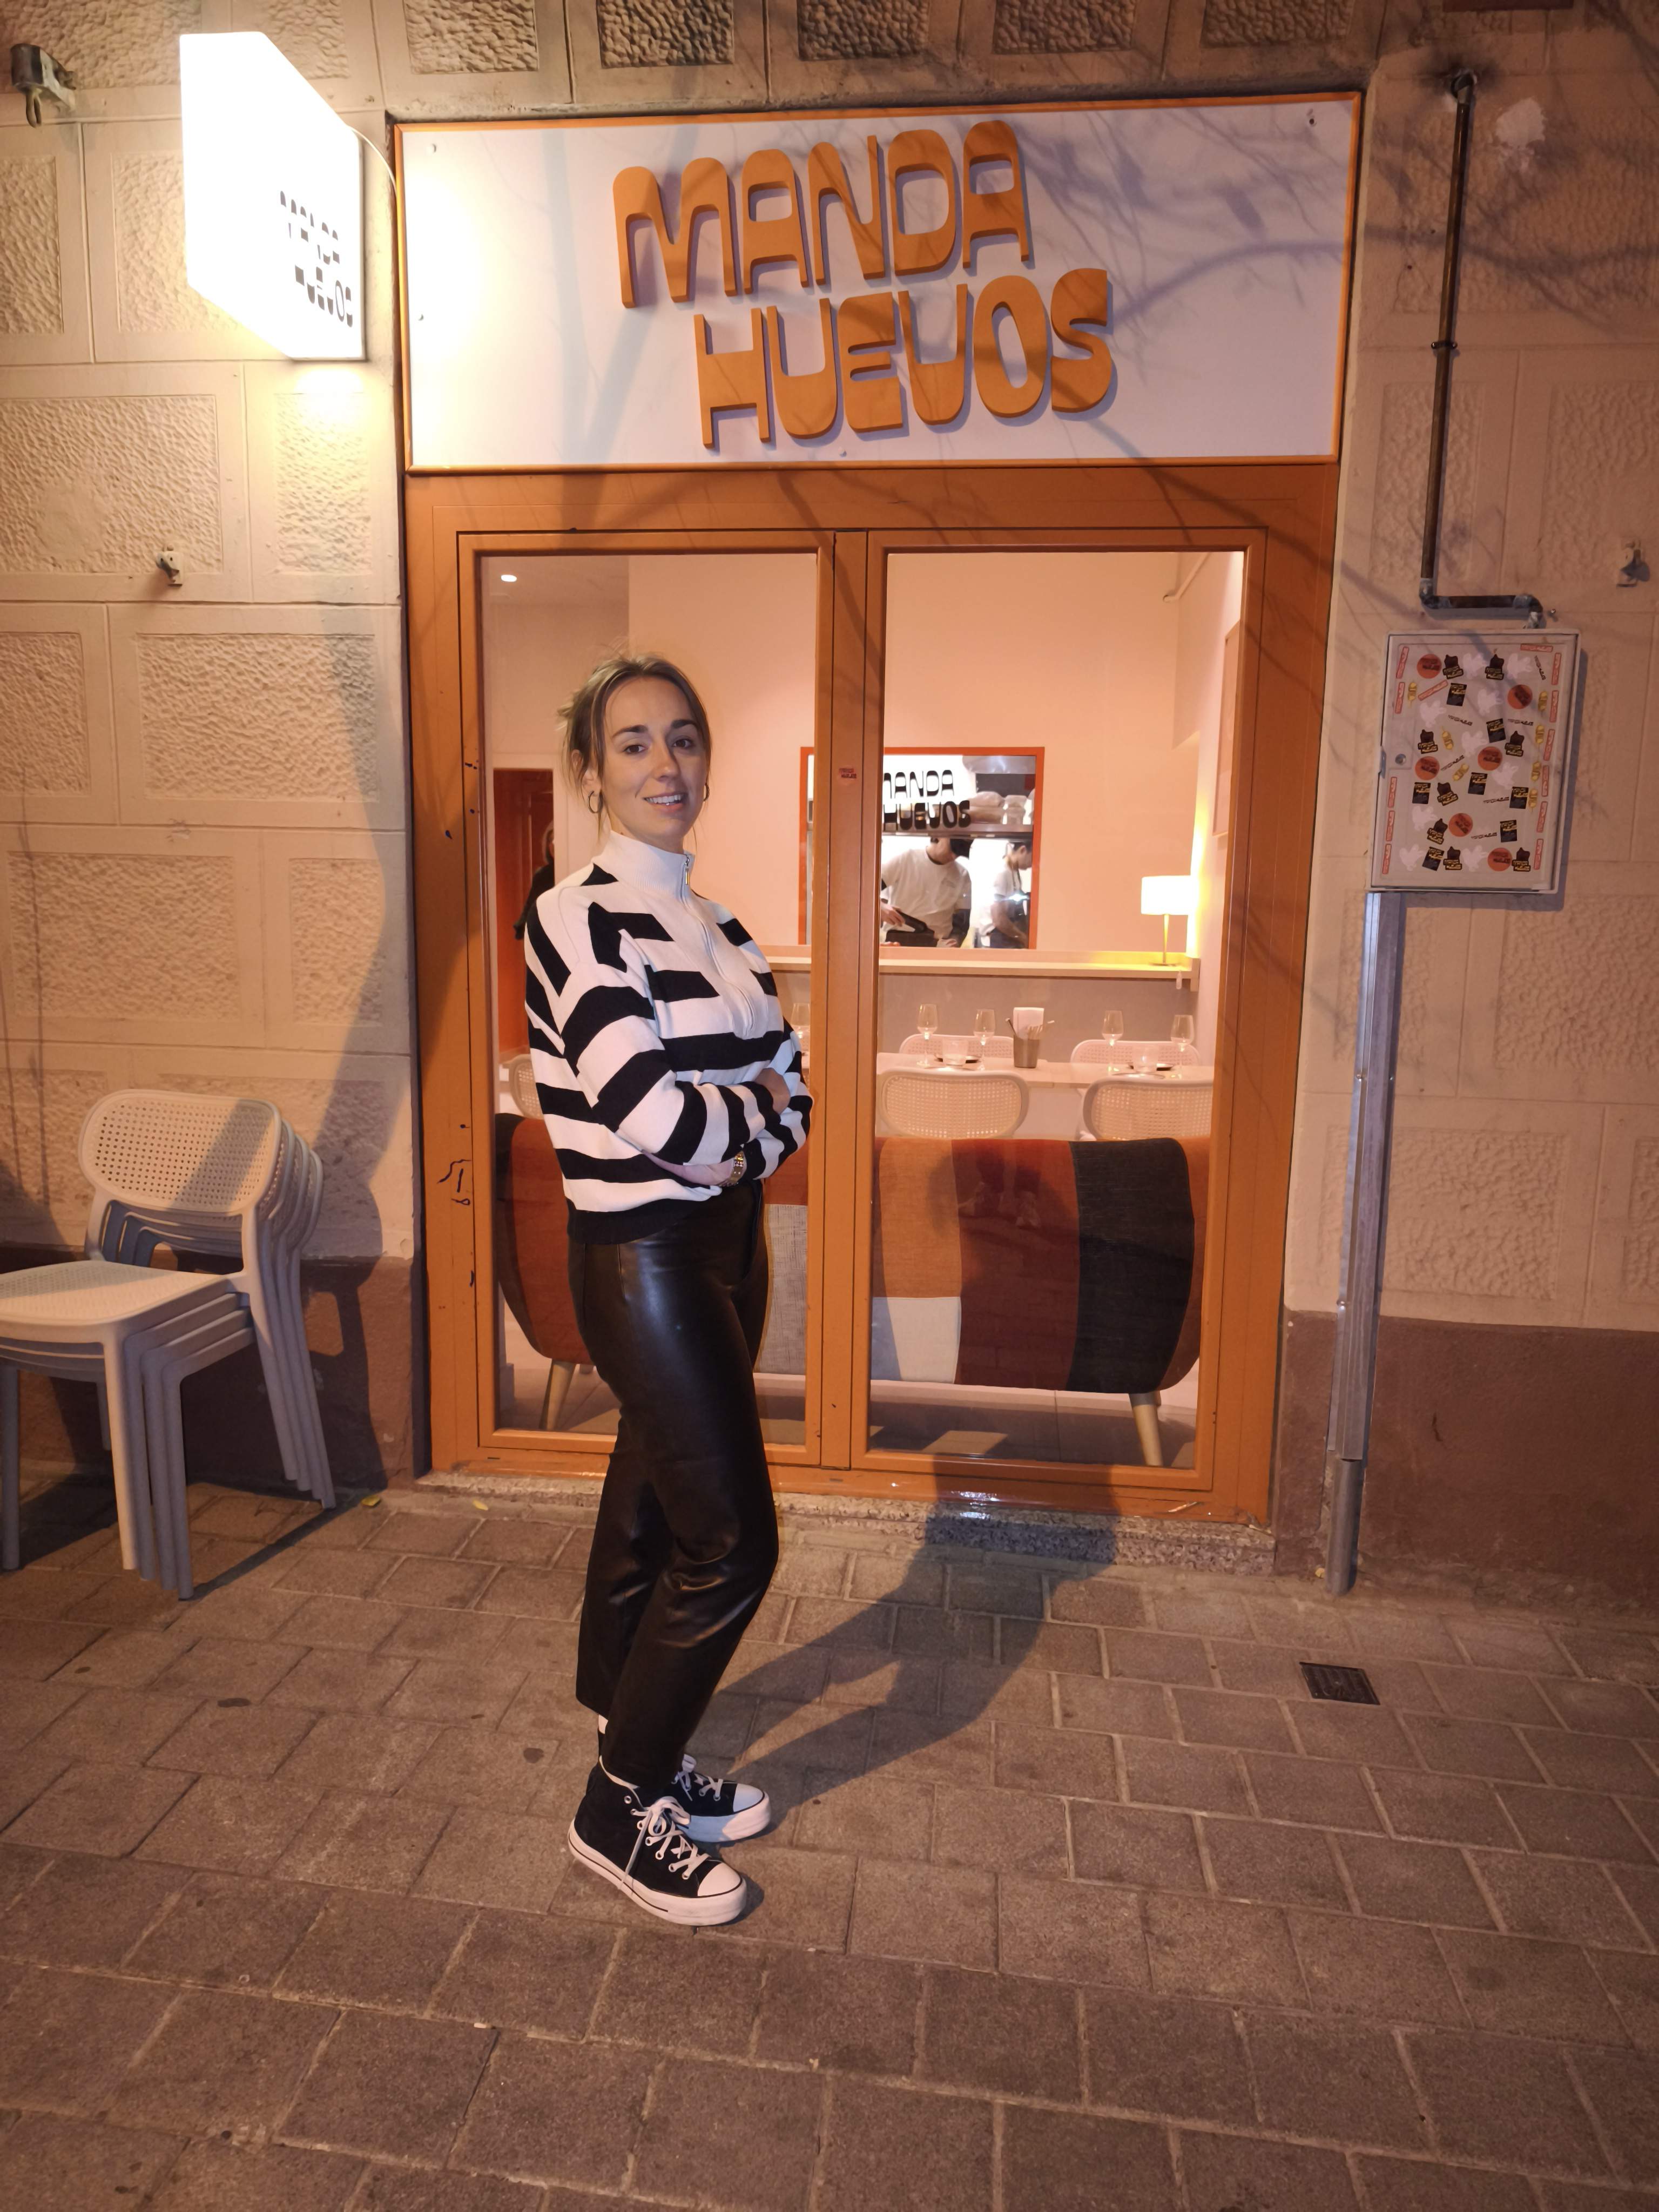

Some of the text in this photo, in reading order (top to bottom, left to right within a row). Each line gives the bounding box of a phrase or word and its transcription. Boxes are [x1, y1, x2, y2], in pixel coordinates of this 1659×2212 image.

[612, 120, 1029, 308] MANDA
[694, 267, 1113, 449] HUEVOS
[884, 800, 971, 831] HUEVOS
